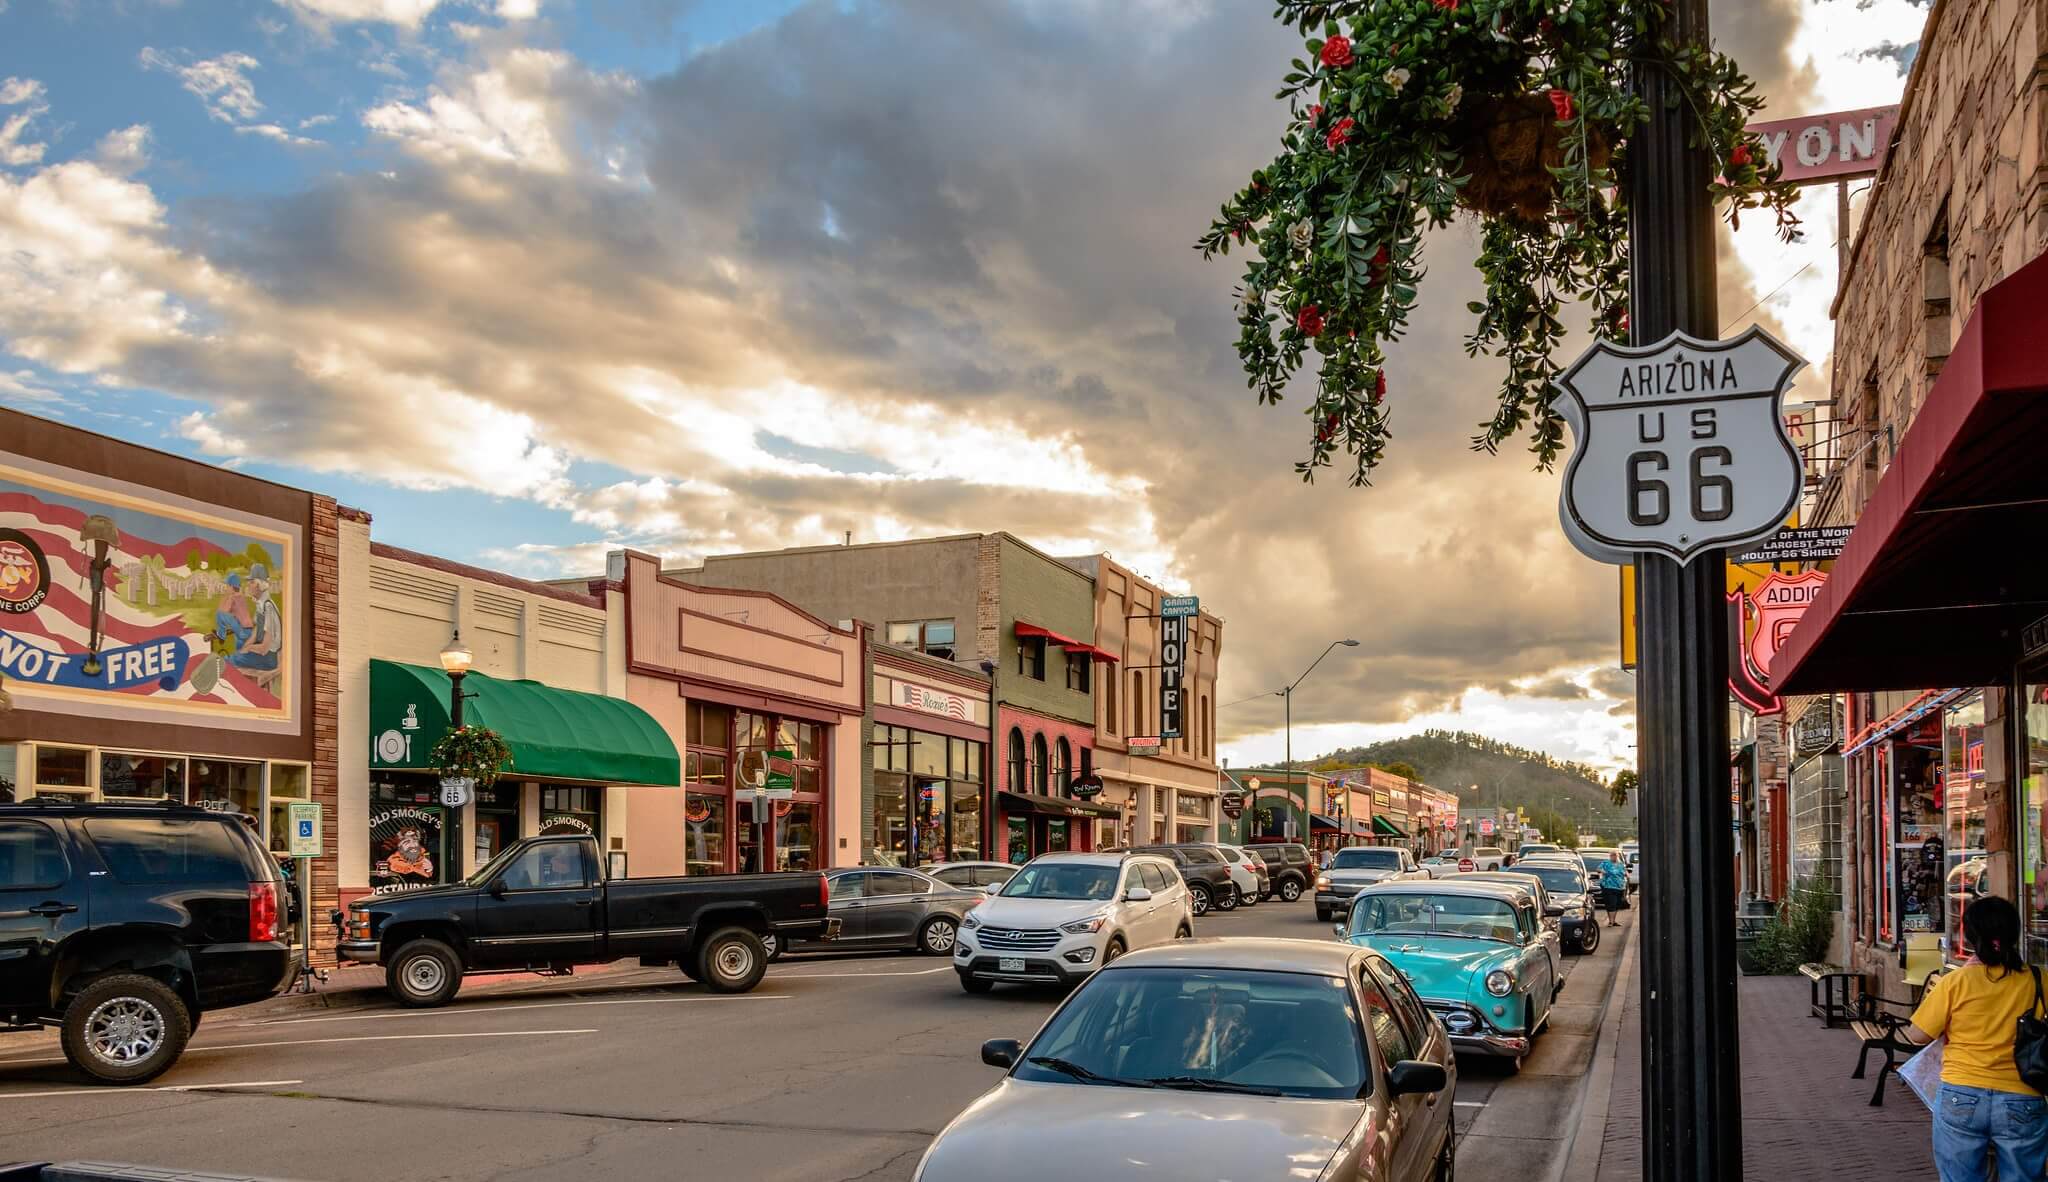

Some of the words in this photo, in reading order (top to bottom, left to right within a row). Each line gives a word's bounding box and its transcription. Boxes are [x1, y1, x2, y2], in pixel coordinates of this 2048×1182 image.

[1619, 357, 1738, 398] ARIZONA
[1626, 446, 1734, 527] 66
[1763, 540, 1814, 550] LARGEST
[1816, 538, 1848, 547] STEE
[1780, 531, 1793, 540] OF
[1797, 530, 1818, 539] THE
[1782, 550, 1797, 558] 66
[16, 590, 46, 612] CORPS
[1163, 606, 1196, 615] CANYON
[0, 635, 70, 682] NOT
[107, 642, 175, 685] FREE
[1163, 620, 1178, 733] HOTEL
[446, 792, 459, 803] 66
[369, 812, 390, 828] OLD
[391, 808, 443, 830] SMOKEY'S
[538, 819, 553, 833] OLD
[554, 816, 592, 835] SMOKEY'S
